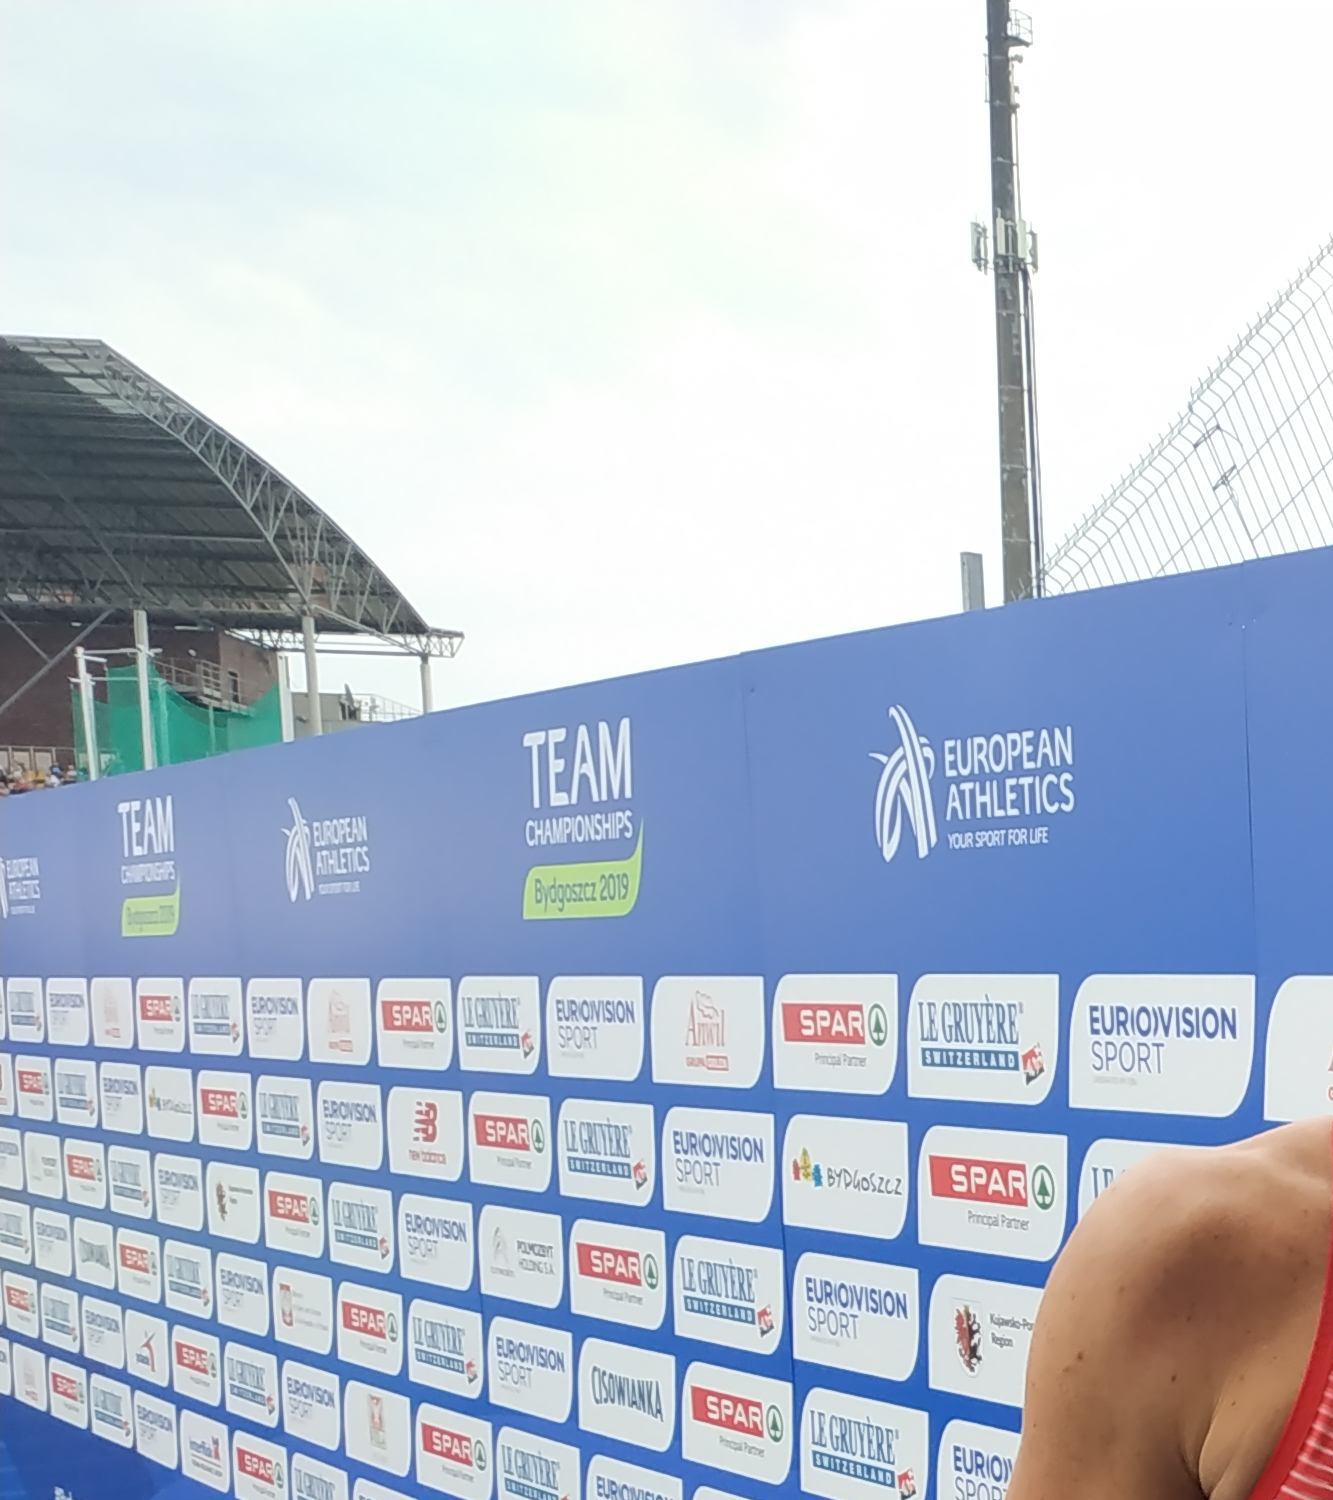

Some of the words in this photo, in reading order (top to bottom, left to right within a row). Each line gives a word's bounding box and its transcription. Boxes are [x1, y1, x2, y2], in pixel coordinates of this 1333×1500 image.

[523, 717, 632, 808] TEAM
[945, 726, 1073, 778] EUROPEAN
[946, 773, 1074, 821] ATHLETICS
[118, 795, 174, 857] TEAM
[313, 817, 367, 846] EUROPEAN
[526, 811, 632, 846] CHAMPIONSHIPS
[948, 833, 973, 849] YOUR
[975, 830, 1005, 847] SPORT
[1008, 829, 1028, 845] FOR
[1030, 827, 1049, 844] LIFE
[316, 847, 369, 875] ATHLETICS
[534, 876, 597, 911] Bydgoszcz
[599, 873, 629, 901] 2019
[392, 1005, 432, 1027] SPAR
[800, 1010, 864, 1037] SPAR
[918, 1002, 939, 1043] LE
[558, 1026, 598, 1050] SPORT
[925, 1049, 1015, 1068] SWITZERLAND
[1091, 1041, 1165, 1074] SPORT
[484, 1120, 530, 1146] SPAR
[564, 1119, 578, 1152] LE
[569, 1158, 630, 1178] SWITZERLAND
[675, 1161, 721, 1187] SPORT
[827, 1168, 902, 1196] BYDGOSZCZ
[951, 1165, 1026, 1199] SPAR
[277, 1196, 308, 1223] SPAR
[968, 1210, 999, 1229] Principal
[1001, 1214, 1030, 1231] Partner
[590, 1250, 641, 1279] SPAR
[681, 1257, 698, 1289] LE
[351, 1306, 386, 1334] SPAR
[687, 1297, 755, 1325] SWITZERLAND
[808, 1307, 859, 1340] SPORT
[499, 1362, 532, 1388] SPORT
[592, 1365, 664, 1422] CISOWIANKA
[707, 1396, 763, 1431] SPAR
[810, 1409, 827, 1447] LE
[432, 1431, 471, 1457] SPAR
[815, 1453, 892, 1486] SWITZERLAND
